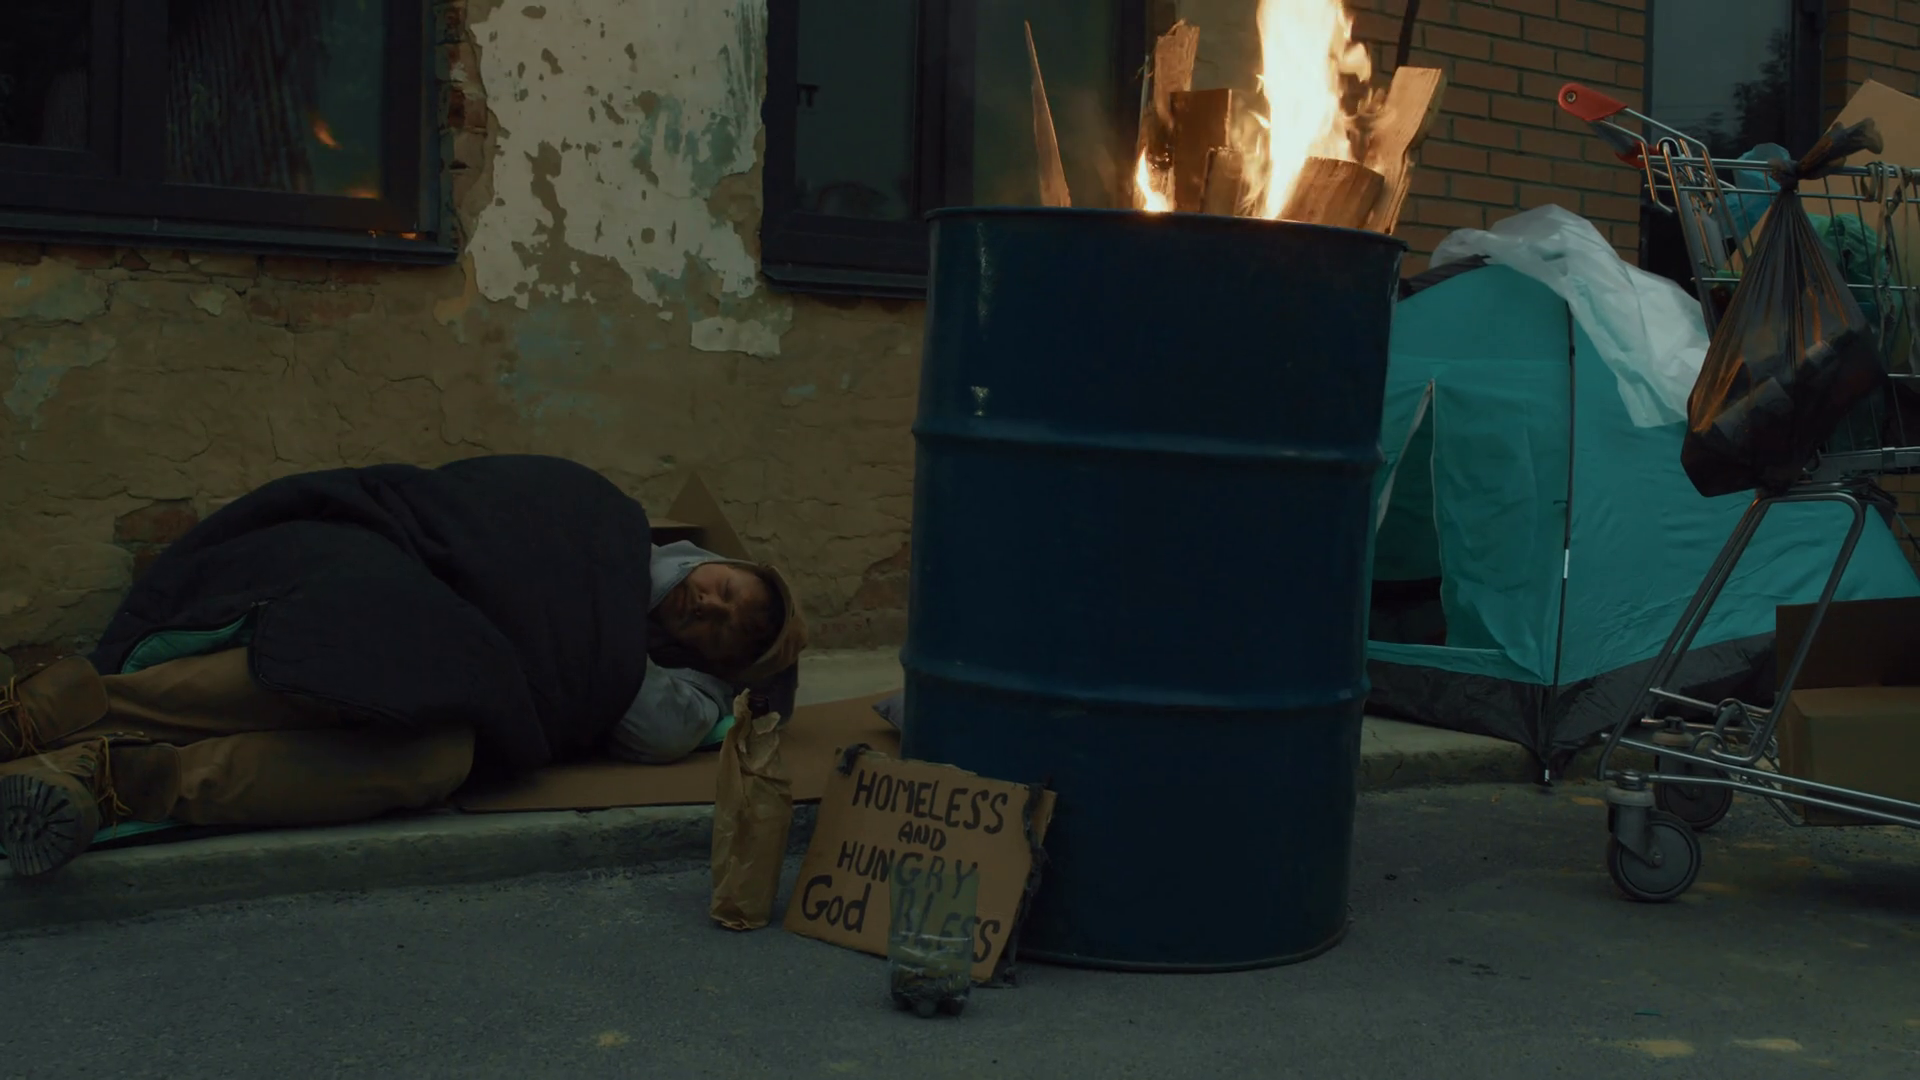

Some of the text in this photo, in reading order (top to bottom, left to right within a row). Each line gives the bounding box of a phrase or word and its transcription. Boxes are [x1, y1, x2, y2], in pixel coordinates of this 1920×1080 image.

[852, 769, 1008, 834] HOMELESS
[898, 821, 947, 851] AND
[837, 841, 978, 899] HUNGRY
[802, 875, 872, 933] God
